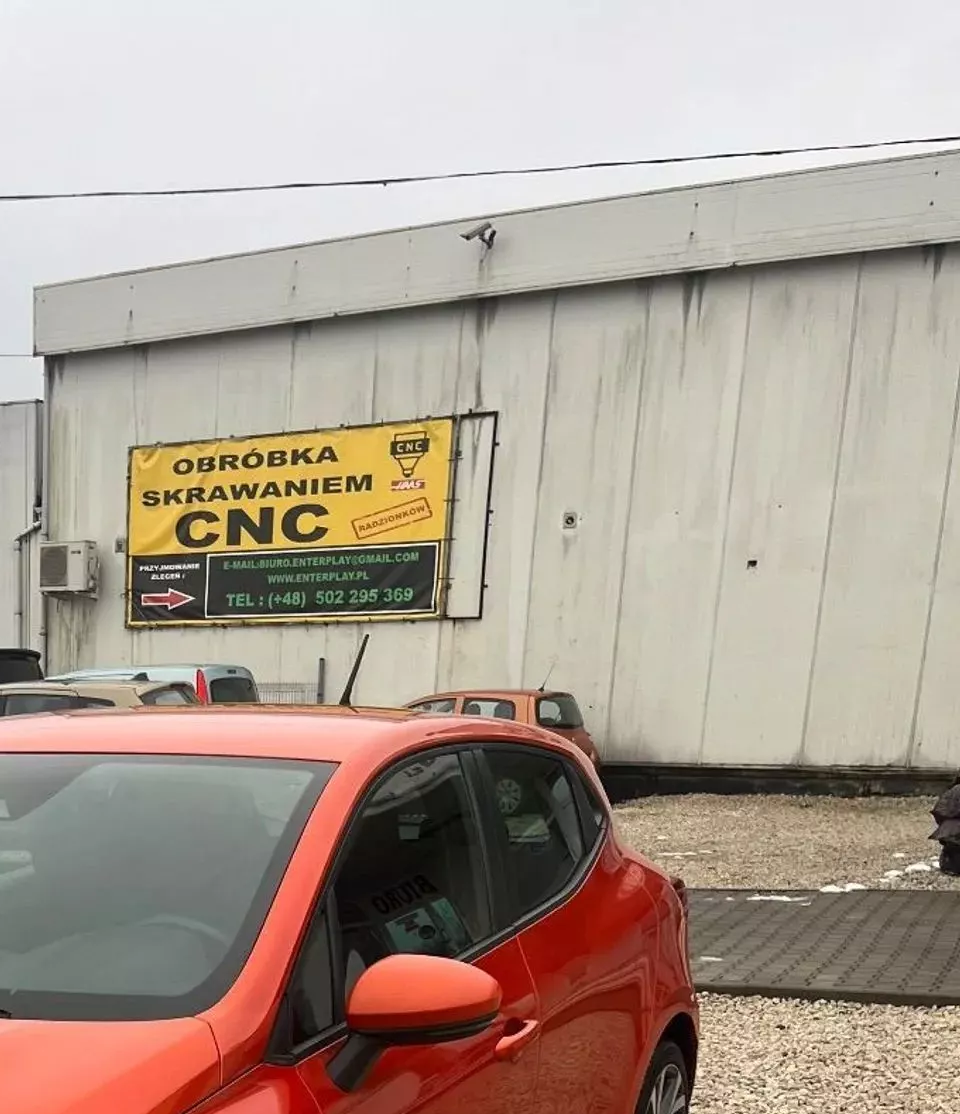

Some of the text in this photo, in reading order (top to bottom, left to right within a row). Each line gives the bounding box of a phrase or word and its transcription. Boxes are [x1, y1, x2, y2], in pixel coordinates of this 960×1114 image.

[396, 441, 423, 453] CNC
[172, 446, 339, 476] OBRÓBKA
[142, 474, 373, 507] SKRAWANIEM
[175, 503, 330, 548] CNC
[267, 571, 370, 584] WWW.ENTERPLAY.PL
[226, 593, 254, 607] TEL
[268, 591, 306, 609] (+48)
[315, 590, 344, 605] 502
[349, 588, 378, 604] 295
[383, 587, 414, 602] 369
